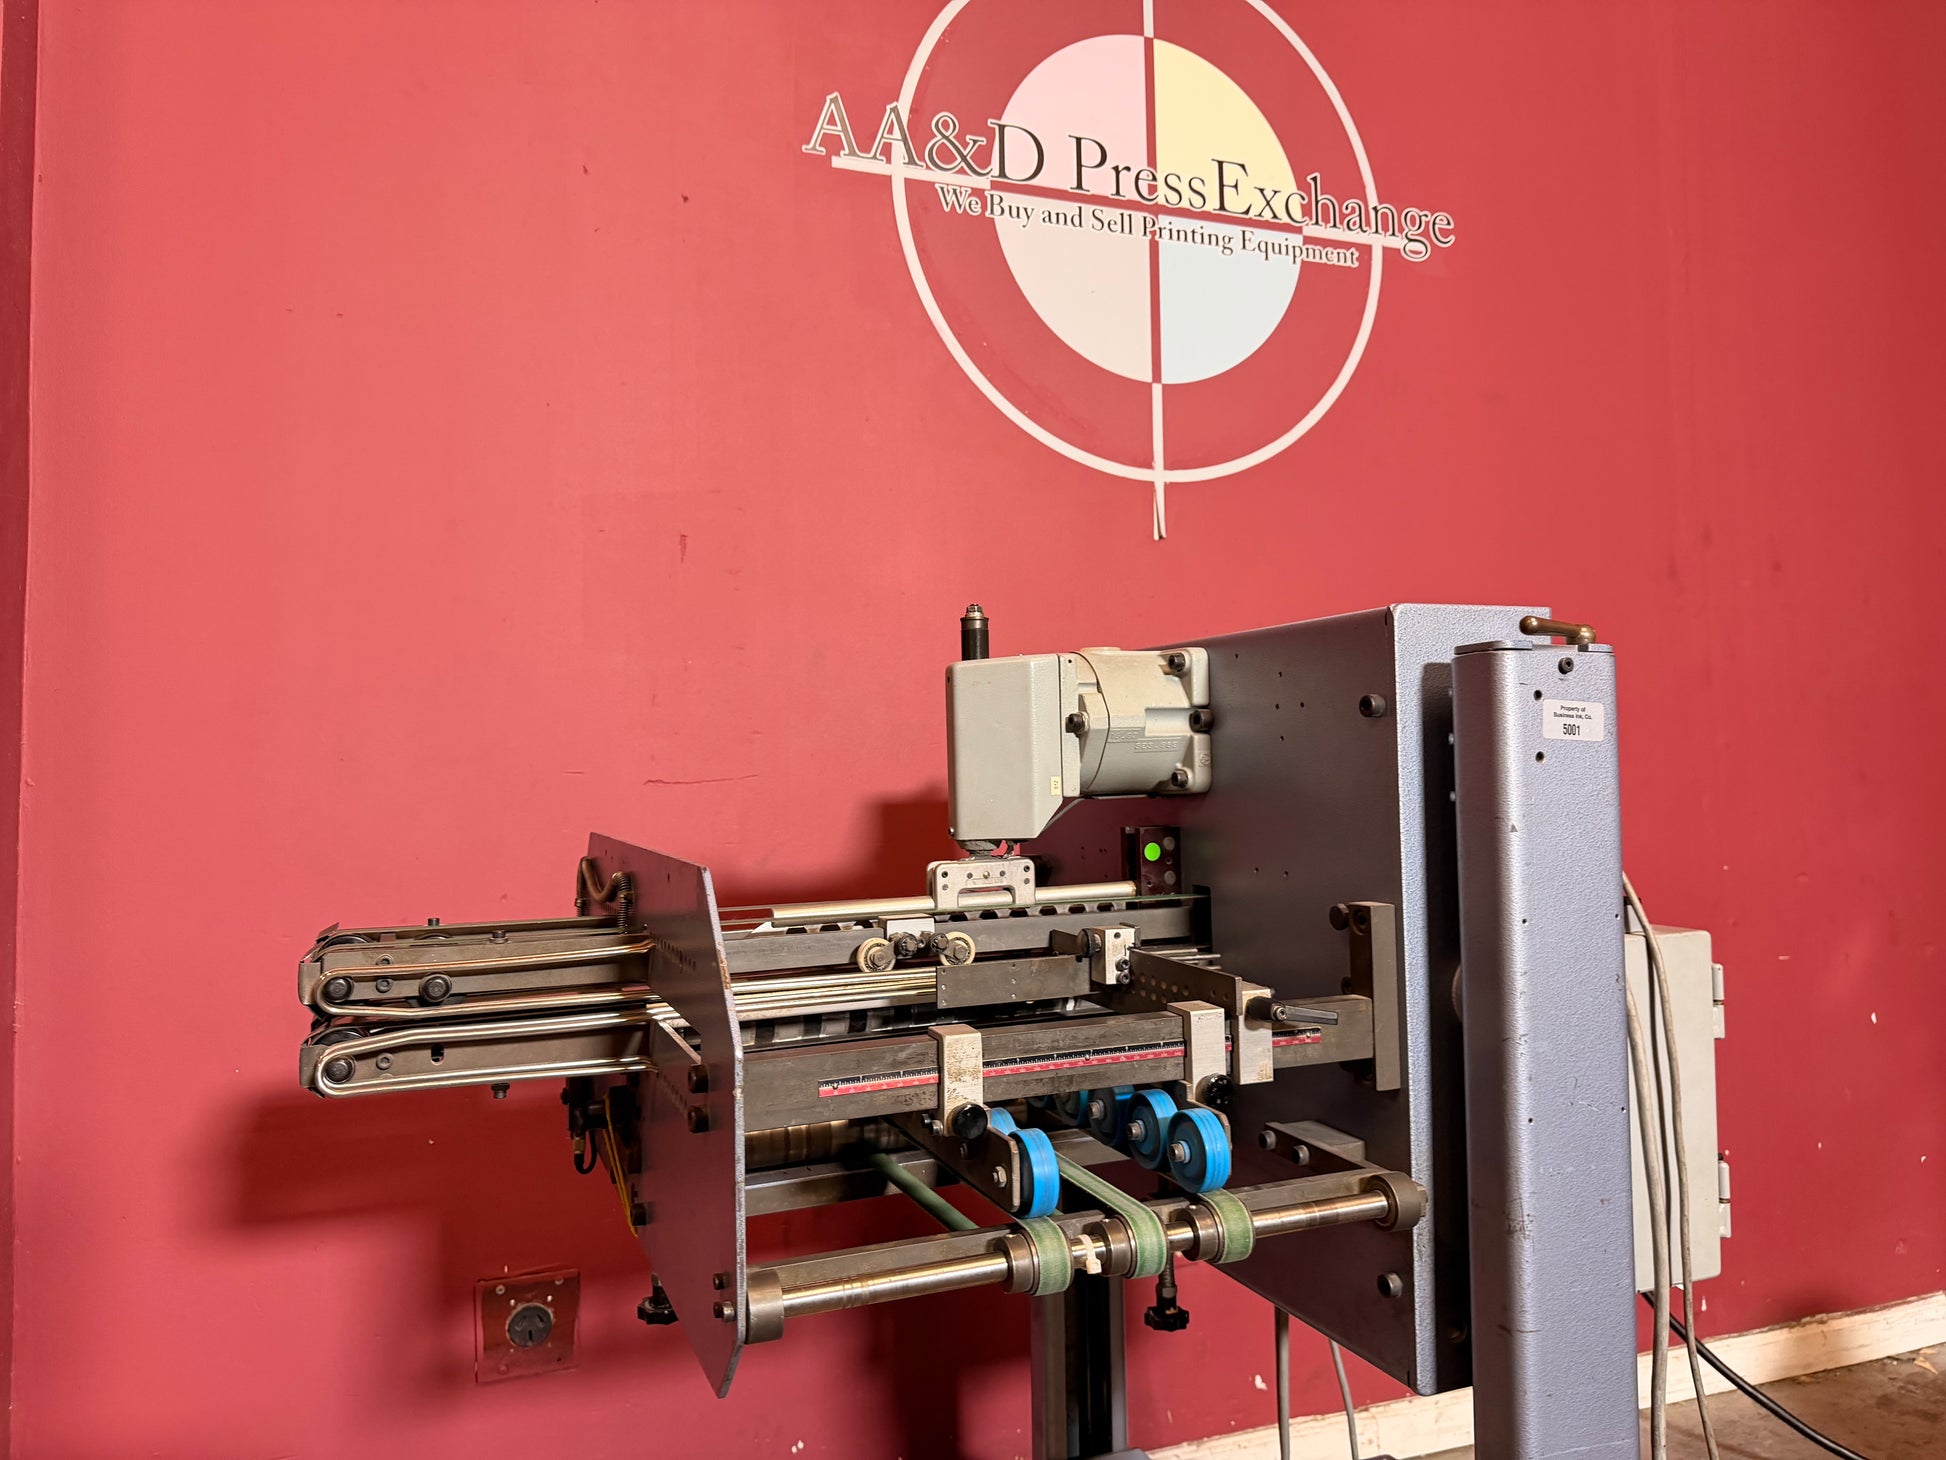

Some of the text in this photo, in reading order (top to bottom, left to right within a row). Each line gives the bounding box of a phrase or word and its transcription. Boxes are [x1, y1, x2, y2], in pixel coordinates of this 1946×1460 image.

[803, 93, 1454, 259] AA&D PressExchange
[936, 186, 1358, 266] We Buy and Sell Printing Equipment
[1562, 723, 1580, 736] 5001
